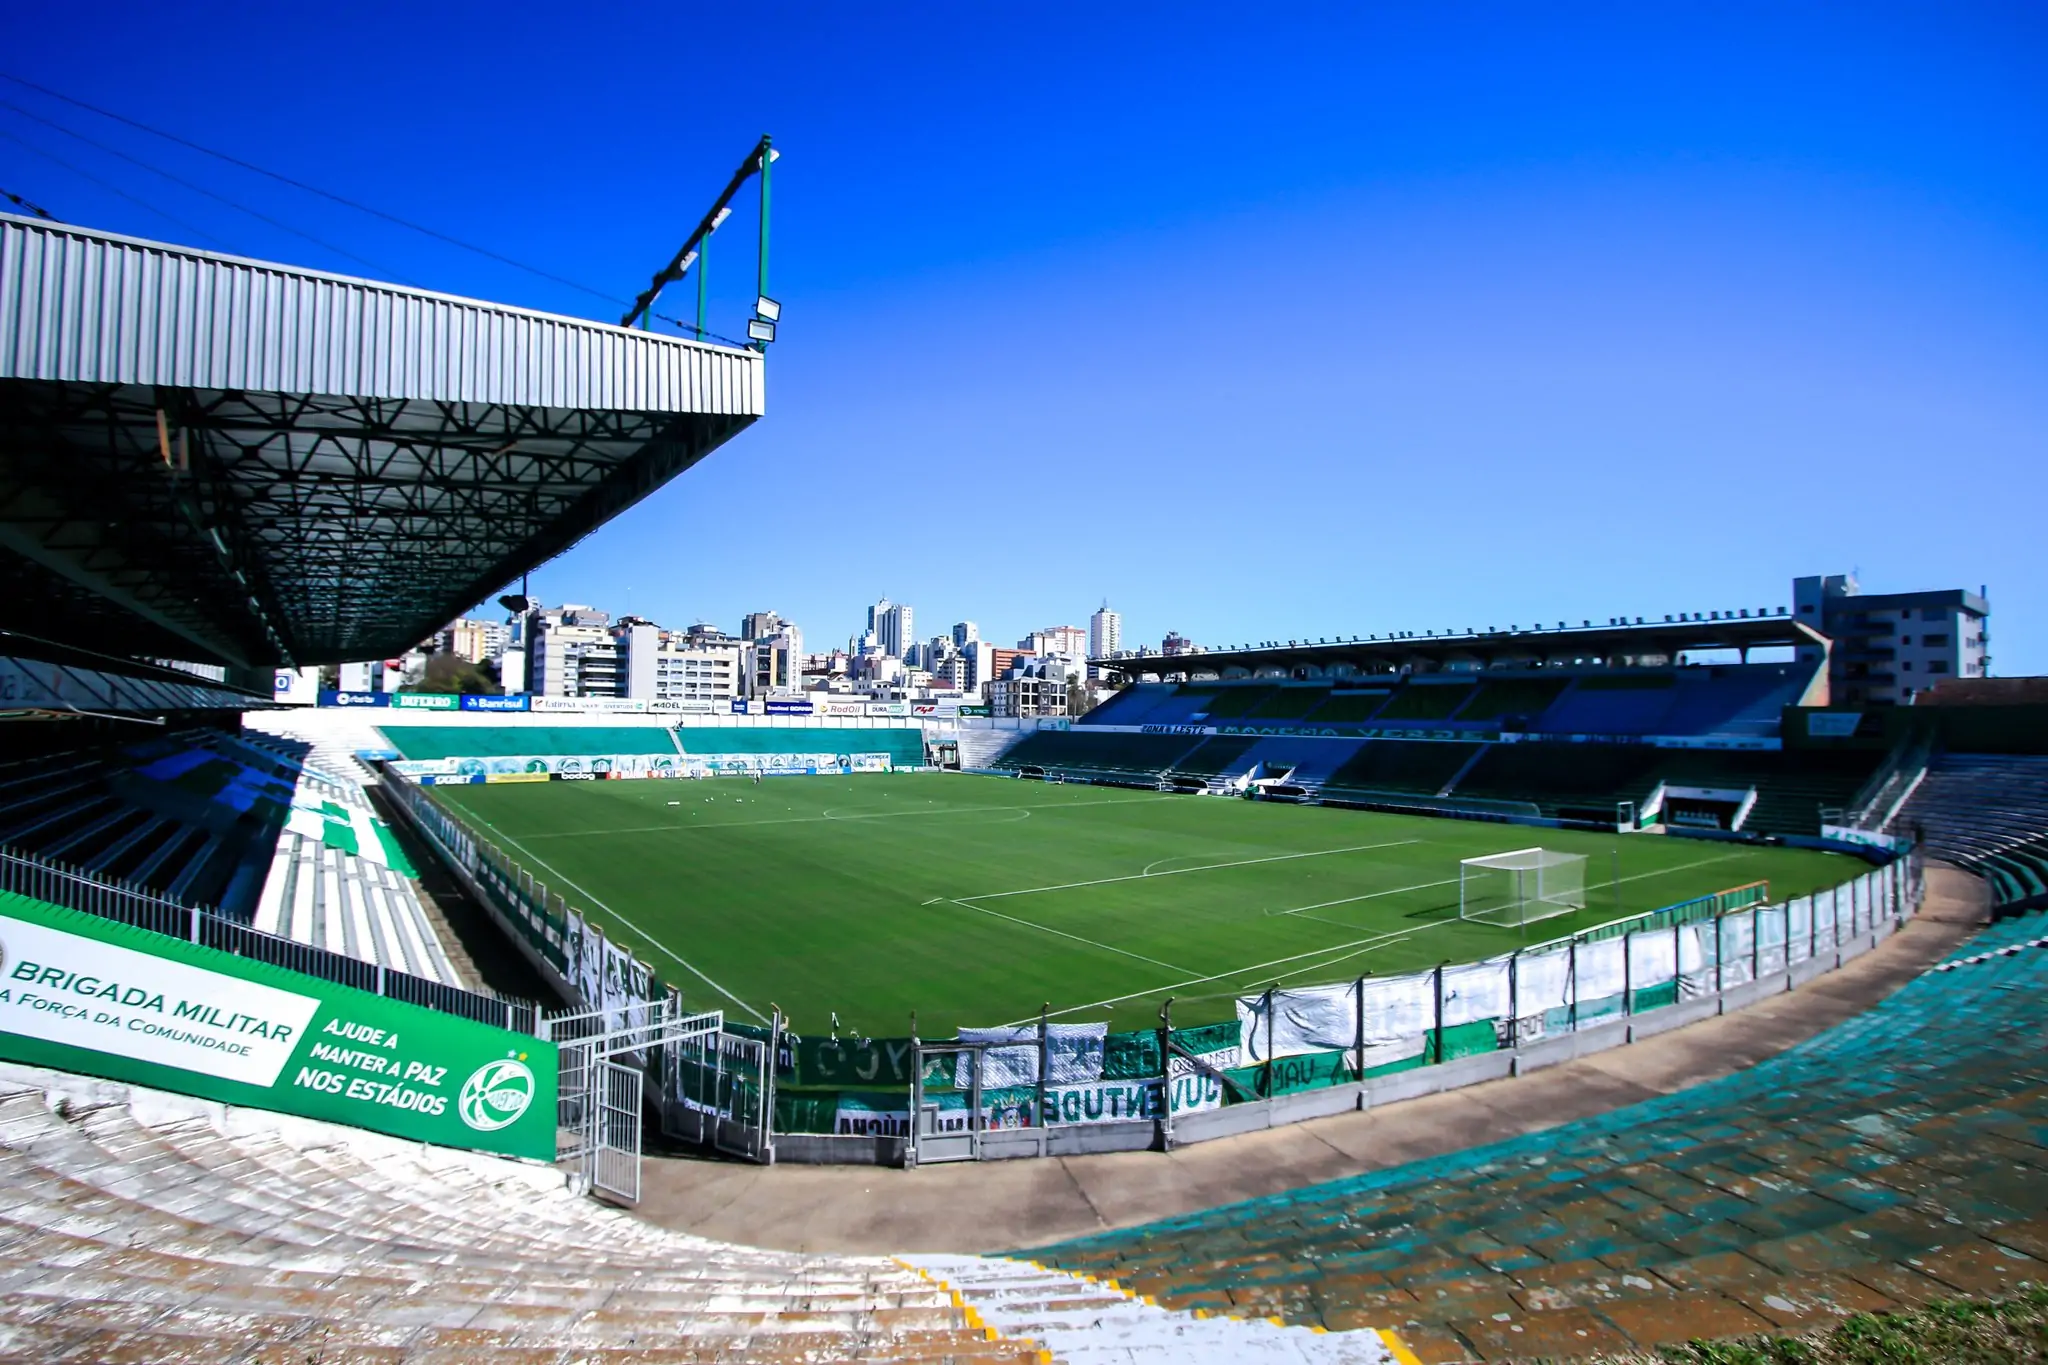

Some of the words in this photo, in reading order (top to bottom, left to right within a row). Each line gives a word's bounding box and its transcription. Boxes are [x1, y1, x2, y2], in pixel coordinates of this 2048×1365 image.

[479, 697, 523, 709] Banrisul
[830, 705, 861, 714] RodOil
[1172, 724, 1208, 735] LESTE
[1224, 726, 1339, 736] MANCHA
[1357, 728, 1484, 740] VERDE
[561, 771, 596, 780] bodog
[0, 988, 11, 1003] A
[17, 993, 89, 1020] FORÇA
[93, 1012, 121, 1028] DA
[10, 960, 165, 1013] BRIGADA
[172, 1000, 293, 1043] MILITAR
[322, 1018, 386, 1046] AJUDE
[382, 1033, 398, 1050] A
[310, 1042, 388, 1074] MANTER
[385, 1061, 401, 1077] A
[403, 1060, 448, 1086] PAZ
[293, 1066, 347, 1094] NOS
[345, 1078, 449, 1116] ESTÁDIOS
